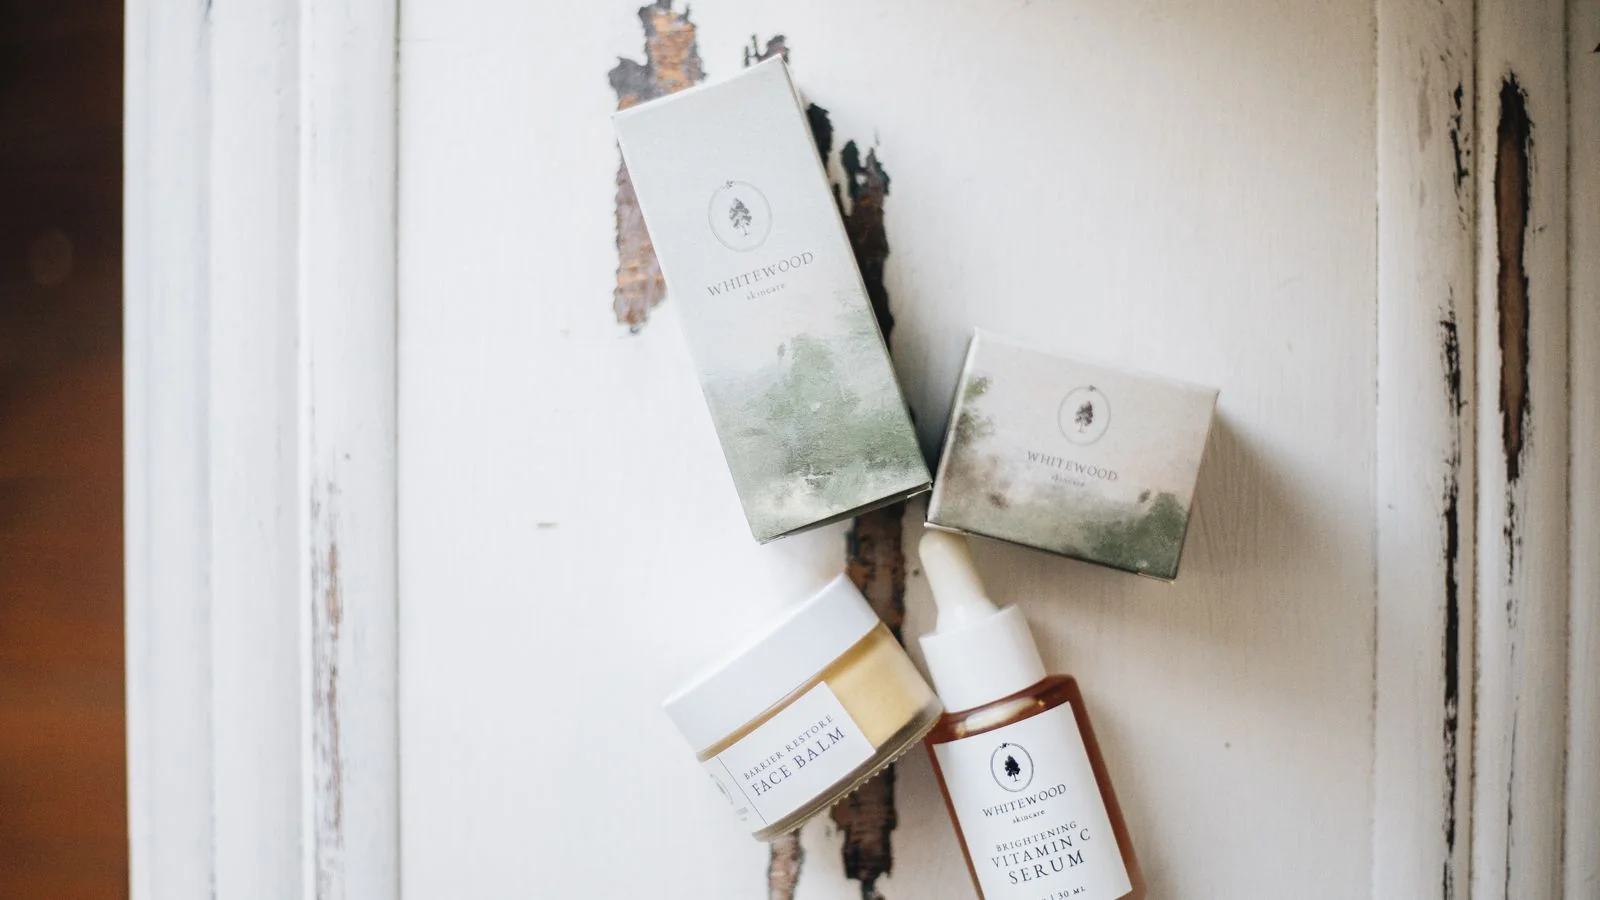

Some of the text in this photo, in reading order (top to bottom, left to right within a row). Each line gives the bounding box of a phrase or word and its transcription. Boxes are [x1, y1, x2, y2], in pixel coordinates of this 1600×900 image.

[707, 251, 814, 296] WHITEWOOD
[746, 283, 786, 301] skincare
[1027, 450, 1118, 481] WHITEWOOD
[743, 714, 833, 780] BARRIER RESTORE
[752, 726, 845, 796] FACE BALM
[982, 783, 1067, 818] WHITEWOOD
[1012, 808, 1046, 824] skincare
[991, 828, 1091, 868] VITAMIN C
[995, 820, 1078, 852] BRIGHTENING
[1008, 849, 1085, 885] SERUM
